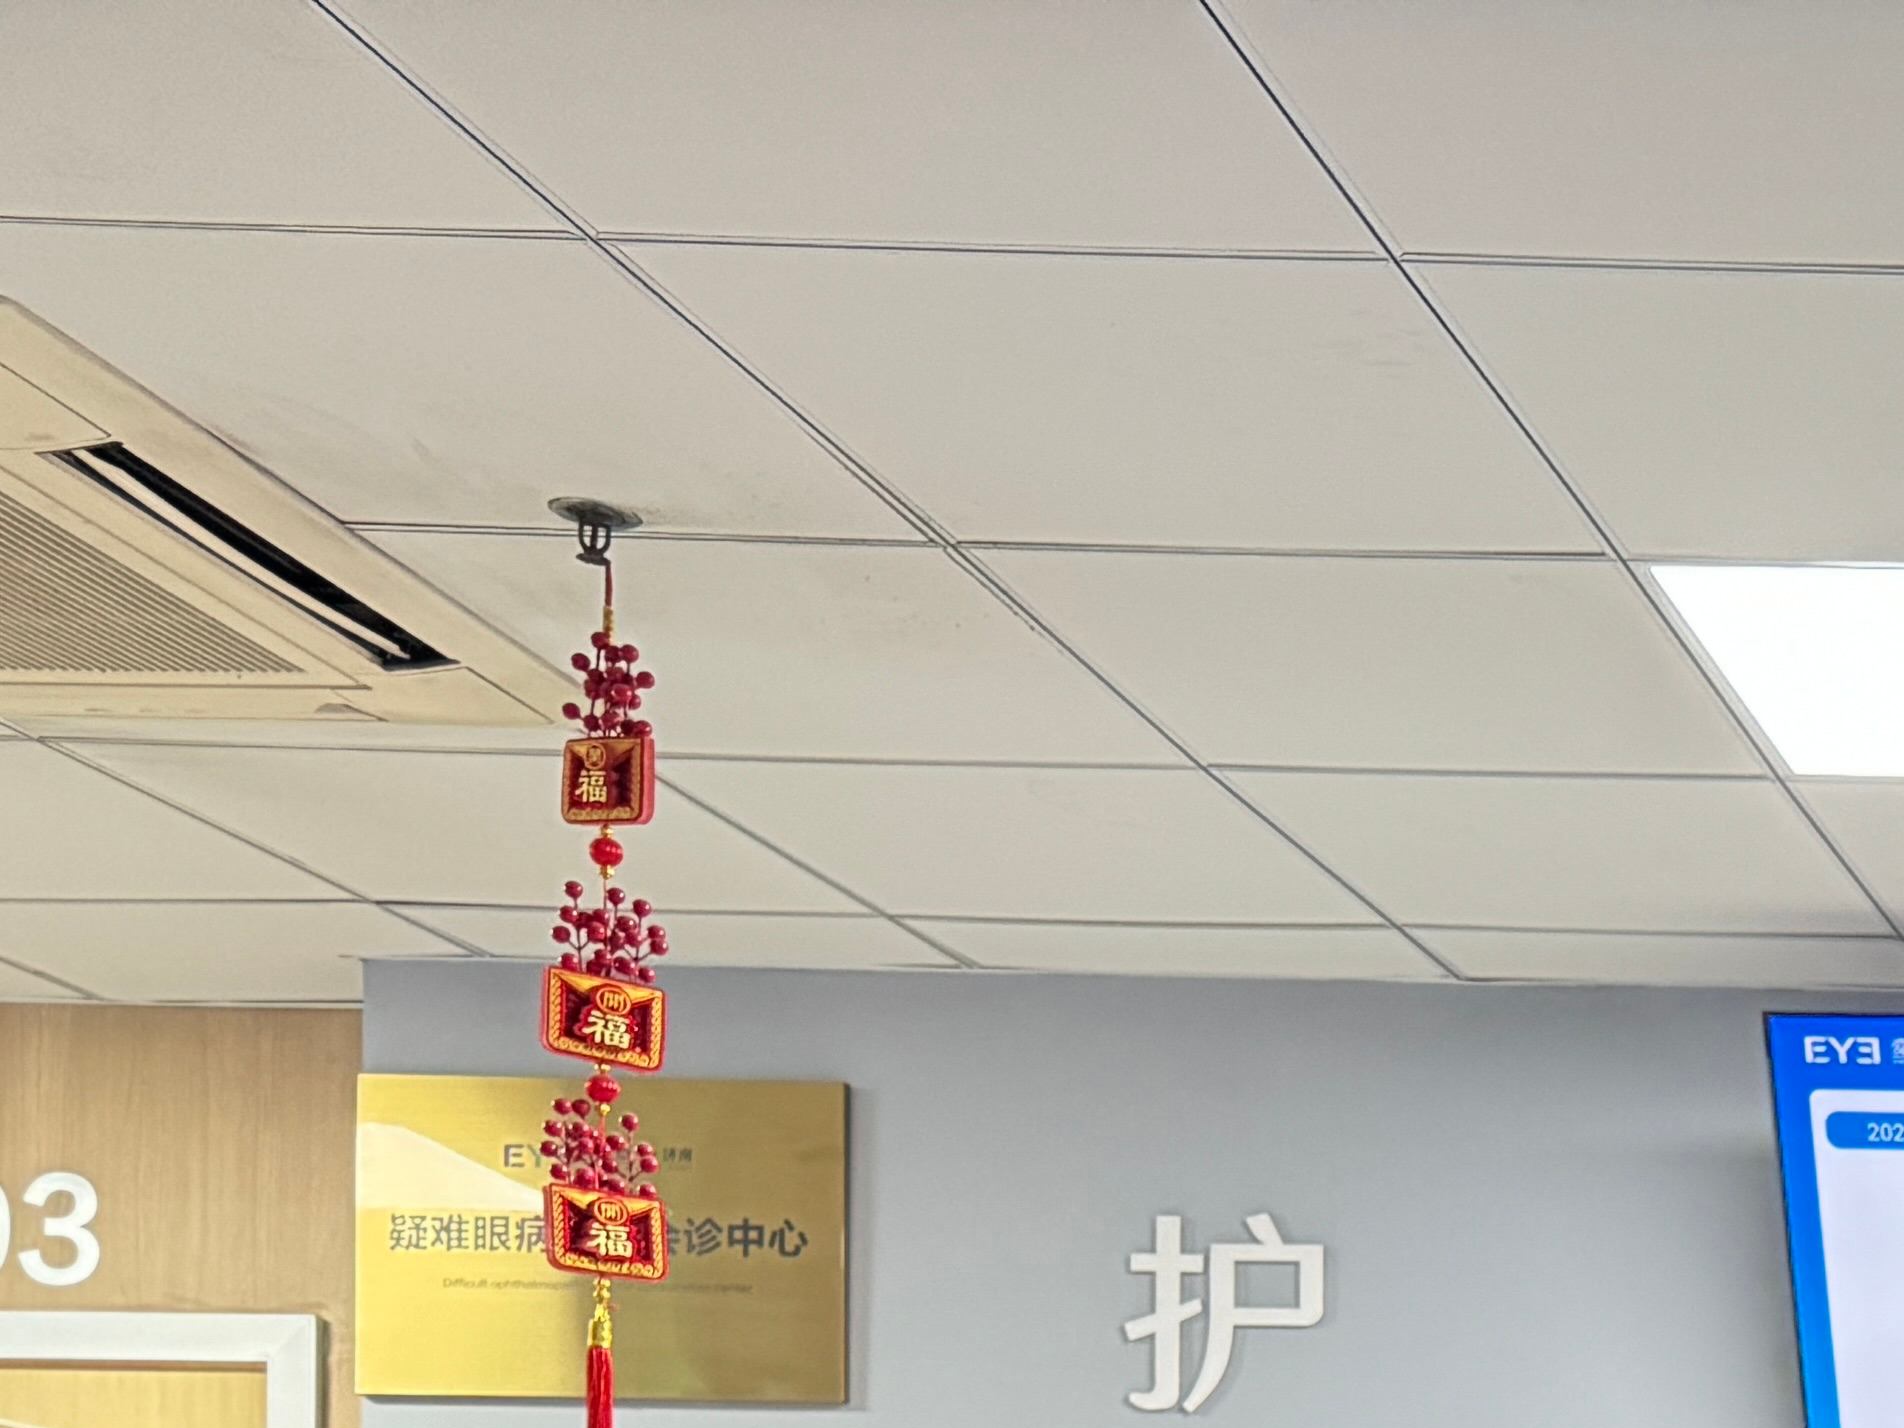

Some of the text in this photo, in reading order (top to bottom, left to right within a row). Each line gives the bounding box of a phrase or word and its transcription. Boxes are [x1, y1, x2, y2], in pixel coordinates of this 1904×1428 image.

[576, 771, 607, 803] 福
[587, 1012, 631, 1049] 福
[1804, 1036, 1880, 1064] EYE
[0, 1172, 100, 1286] 3
[589, 1225, 633, 1259] 福
